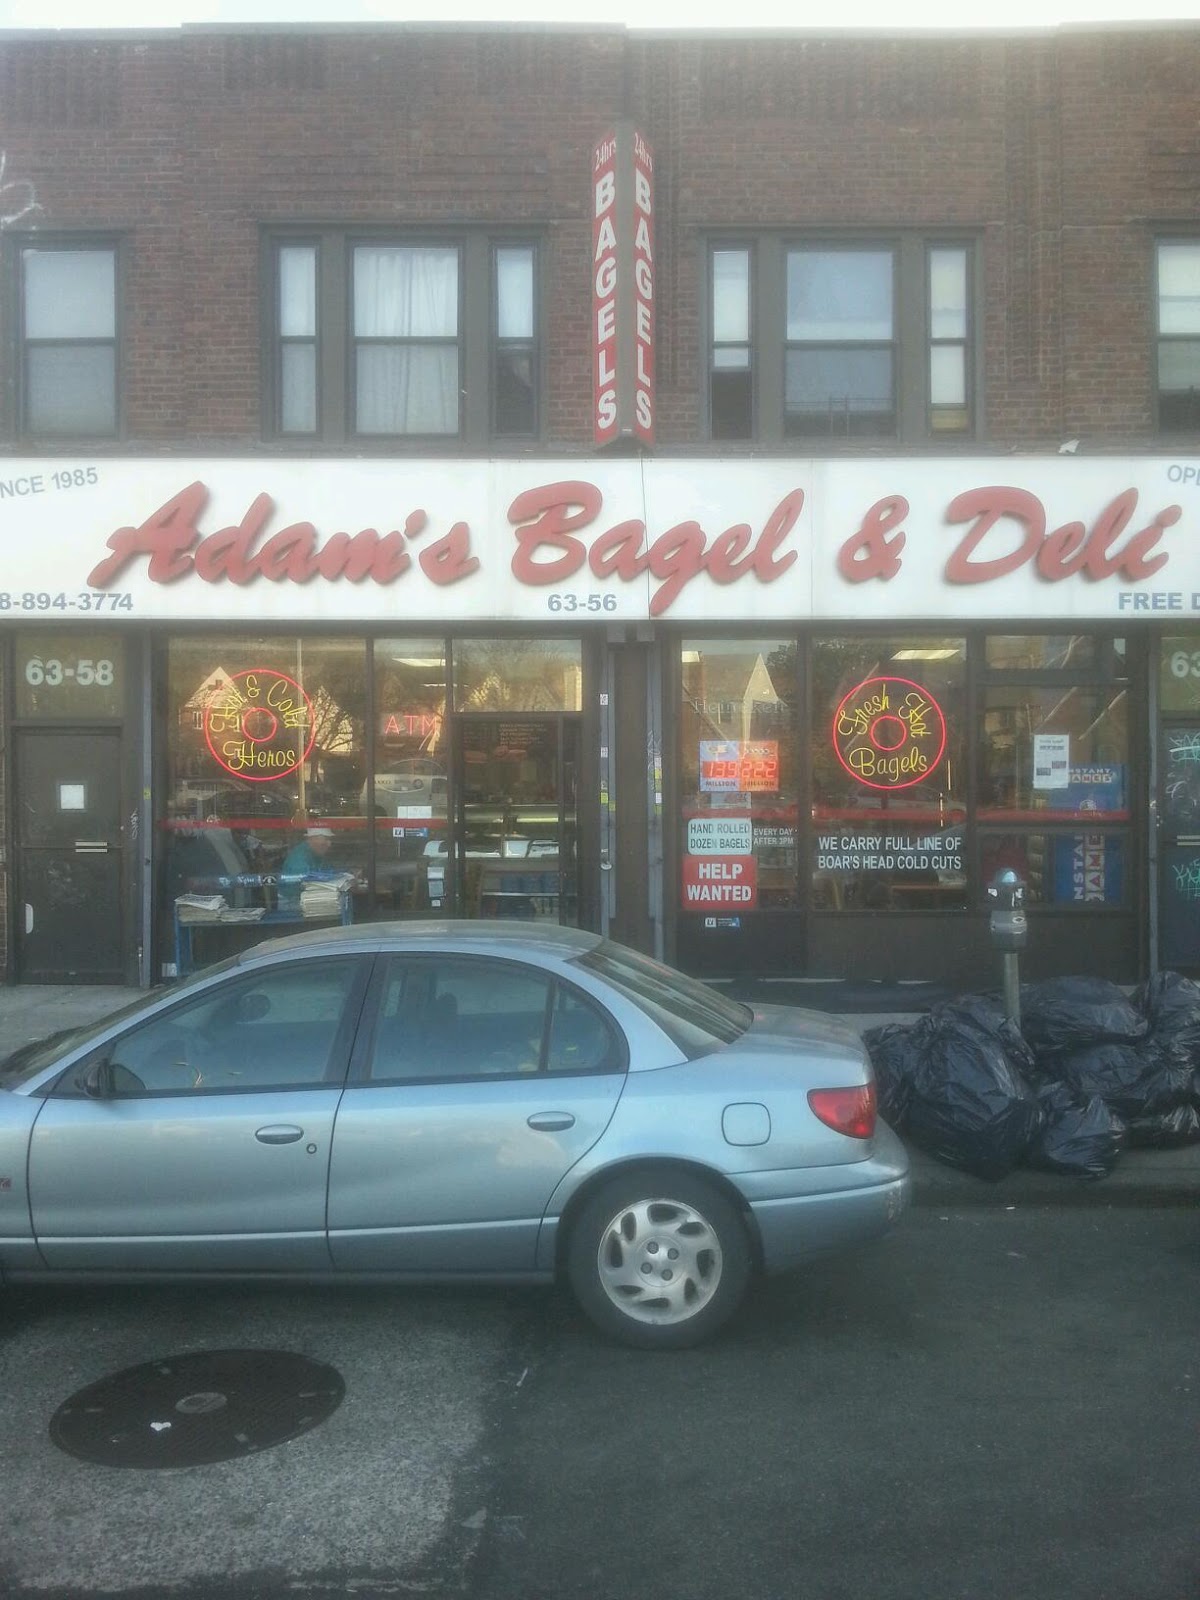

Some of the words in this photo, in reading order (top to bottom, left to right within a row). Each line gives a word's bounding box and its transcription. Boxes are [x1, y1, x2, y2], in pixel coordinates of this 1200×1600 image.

[595, 170, 617, 429] BAGELS
[635, 167, 653, 429] BAGELS
[51, 467, 99, 490] 1985
[87, 480, 480, 588] Adam's
[507, 480, 804, 617] Bagel
[837, 494, 910, 584] &
[944, 485, 1183, 584] Deli
[547, 594, 617, 611] 63-56
[1118, 592, 1183, 610] FREE
[25, 659, 114, 686] 63-58
[246, 674, 262, 698] &
[267, 679, 311, 729] Cold
[838, 683, 889, 736] Fresh
[898, 692, 933, 738] Hot
[384, 714, 438, 736] ATM
[222, 740, 296, 771] Heros
[848, 746, 928, 782] Bagels
[690, 823, 714, 834] HAND
[717, 823, 750, 834] ROLLED
[753, 827, 778, 836] EVERY
[779, 827, 794, 836] DAY
[690, 838, 719, 849] DOZEN
[720, 838, 750, 849] BAGELS
[753, 837, 777, 846] AFTER
[818, 836, 838, 850] WE
[841, 836, 882, 850] CARRY
[885, 836, 914, 850] FULL
[917, 836, 942, 850] LINE
[945, 836, 962, 850] OF
[698, 862, 743, 880] HELP
[818, 855, 860, 869] BOAR'S
[863, 855, 894, 869] HEAD
[897, 855, 928, 869] COLD
[931, 855, 962, 869] CUTS
[687, 884, 752, 901] WANTED
